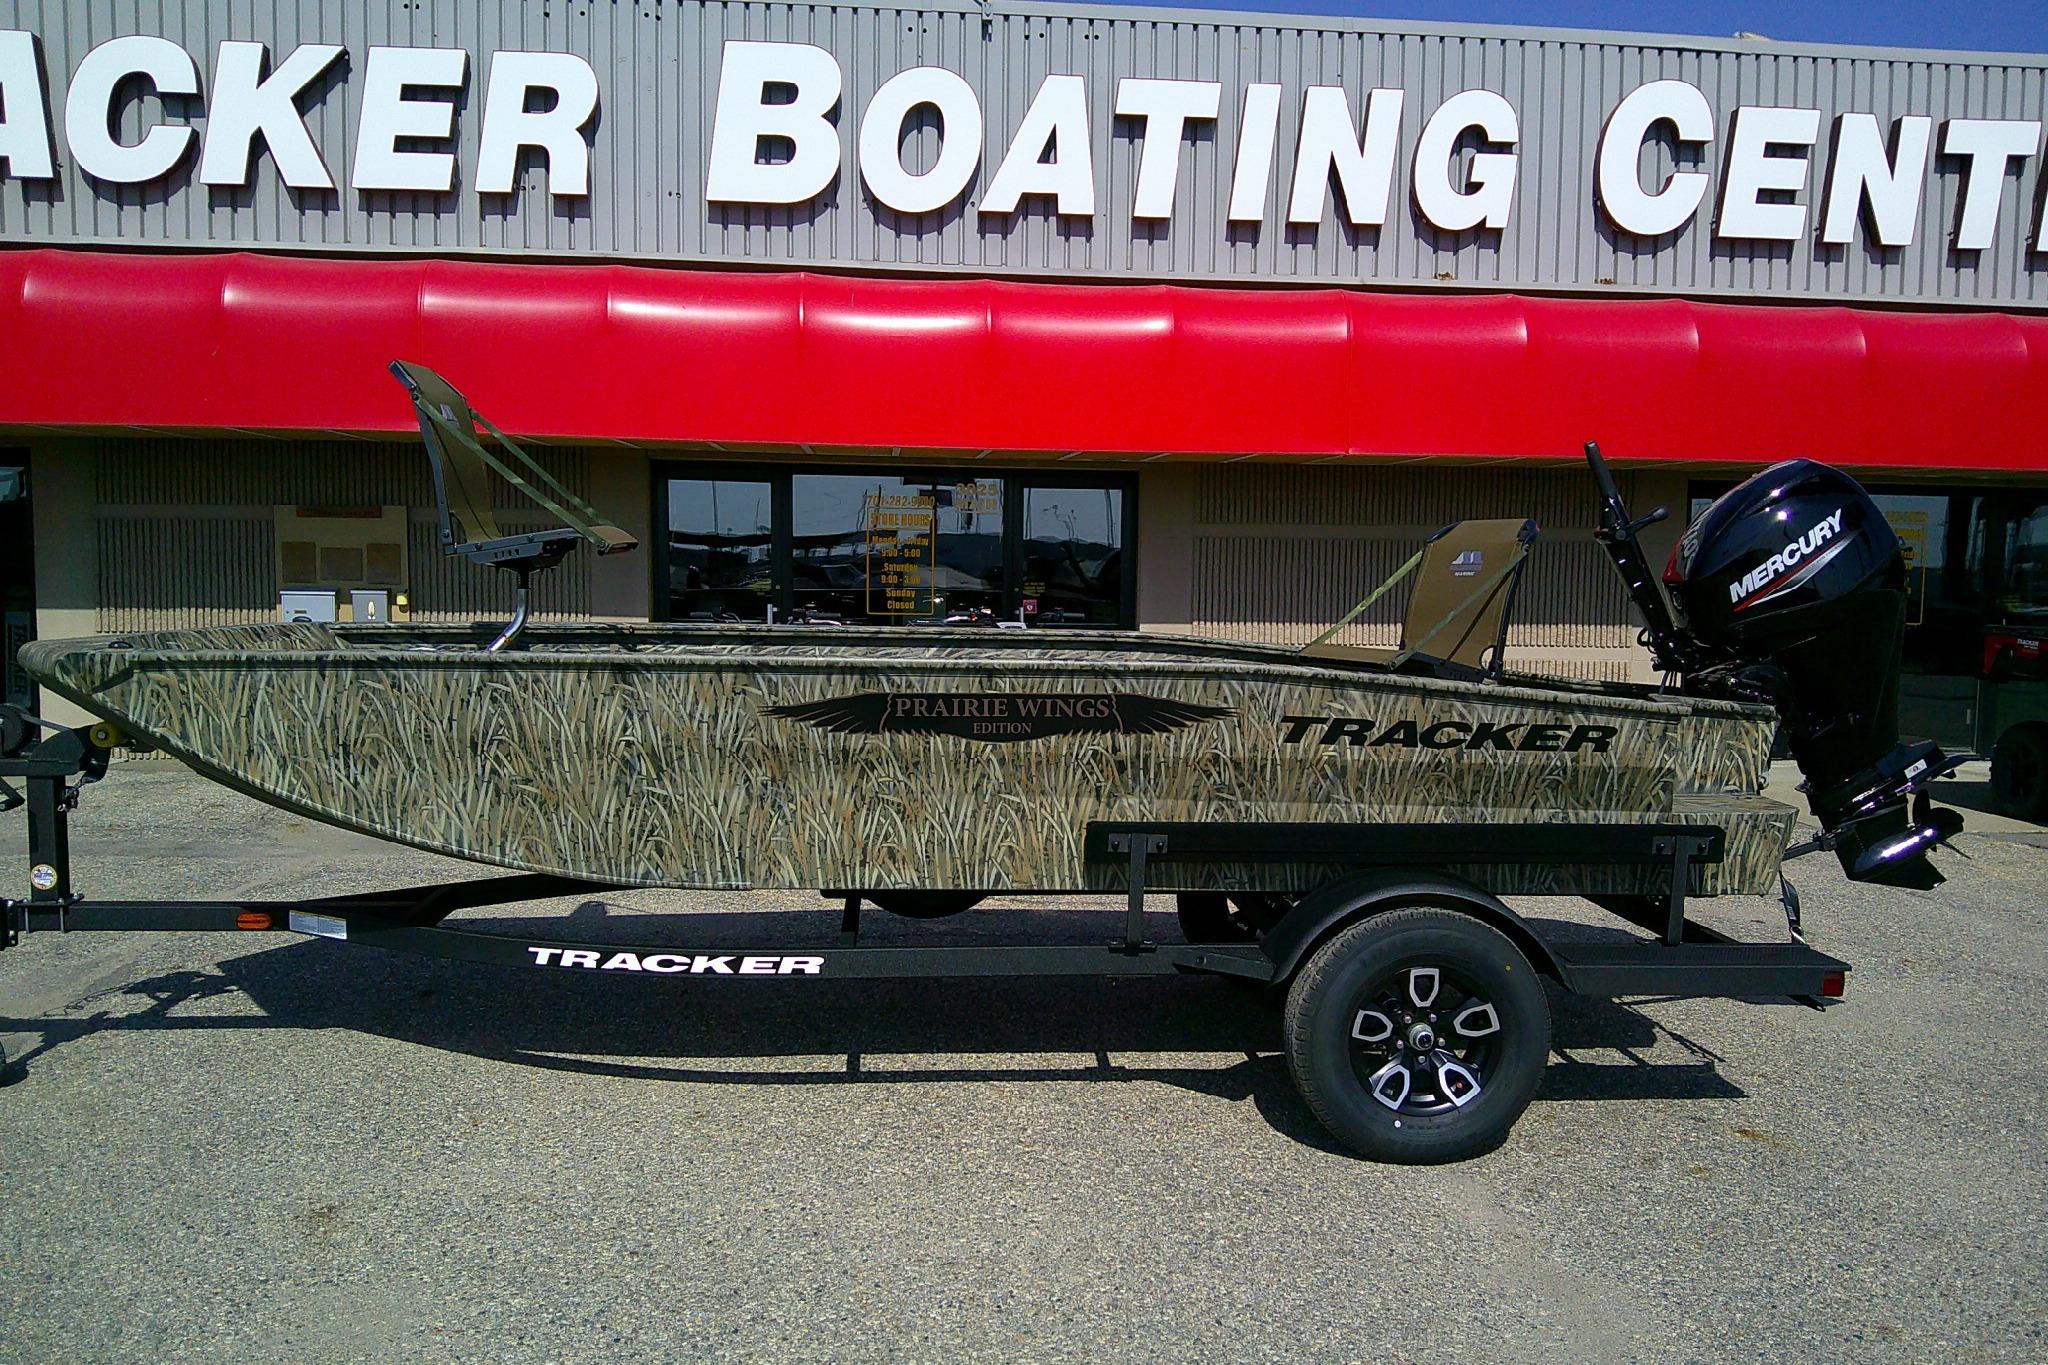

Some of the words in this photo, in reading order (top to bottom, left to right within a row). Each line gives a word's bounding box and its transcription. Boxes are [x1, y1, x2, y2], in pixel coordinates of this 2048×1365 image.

[704, 40, 1520, 230] BOATING
[1600, 79, 2048, 252] CENT
[901, 512, 930, 527] HOURS
[1729, 488, 1842, 603] MERCURY
[883, 562, 918, 573] Saturday
[886, 588, 916, 598] Sunday
[887, 600, 915, 609] Closed
[895, 698, 1009, 718] PRAIRIE
[1015, 698, 1110, 718] WINGS
[973, 722, 1032, 735] EDITION
[1279, 714, 1619, 754] TRACKER
[527, 946, 825, 974] TRACKER
